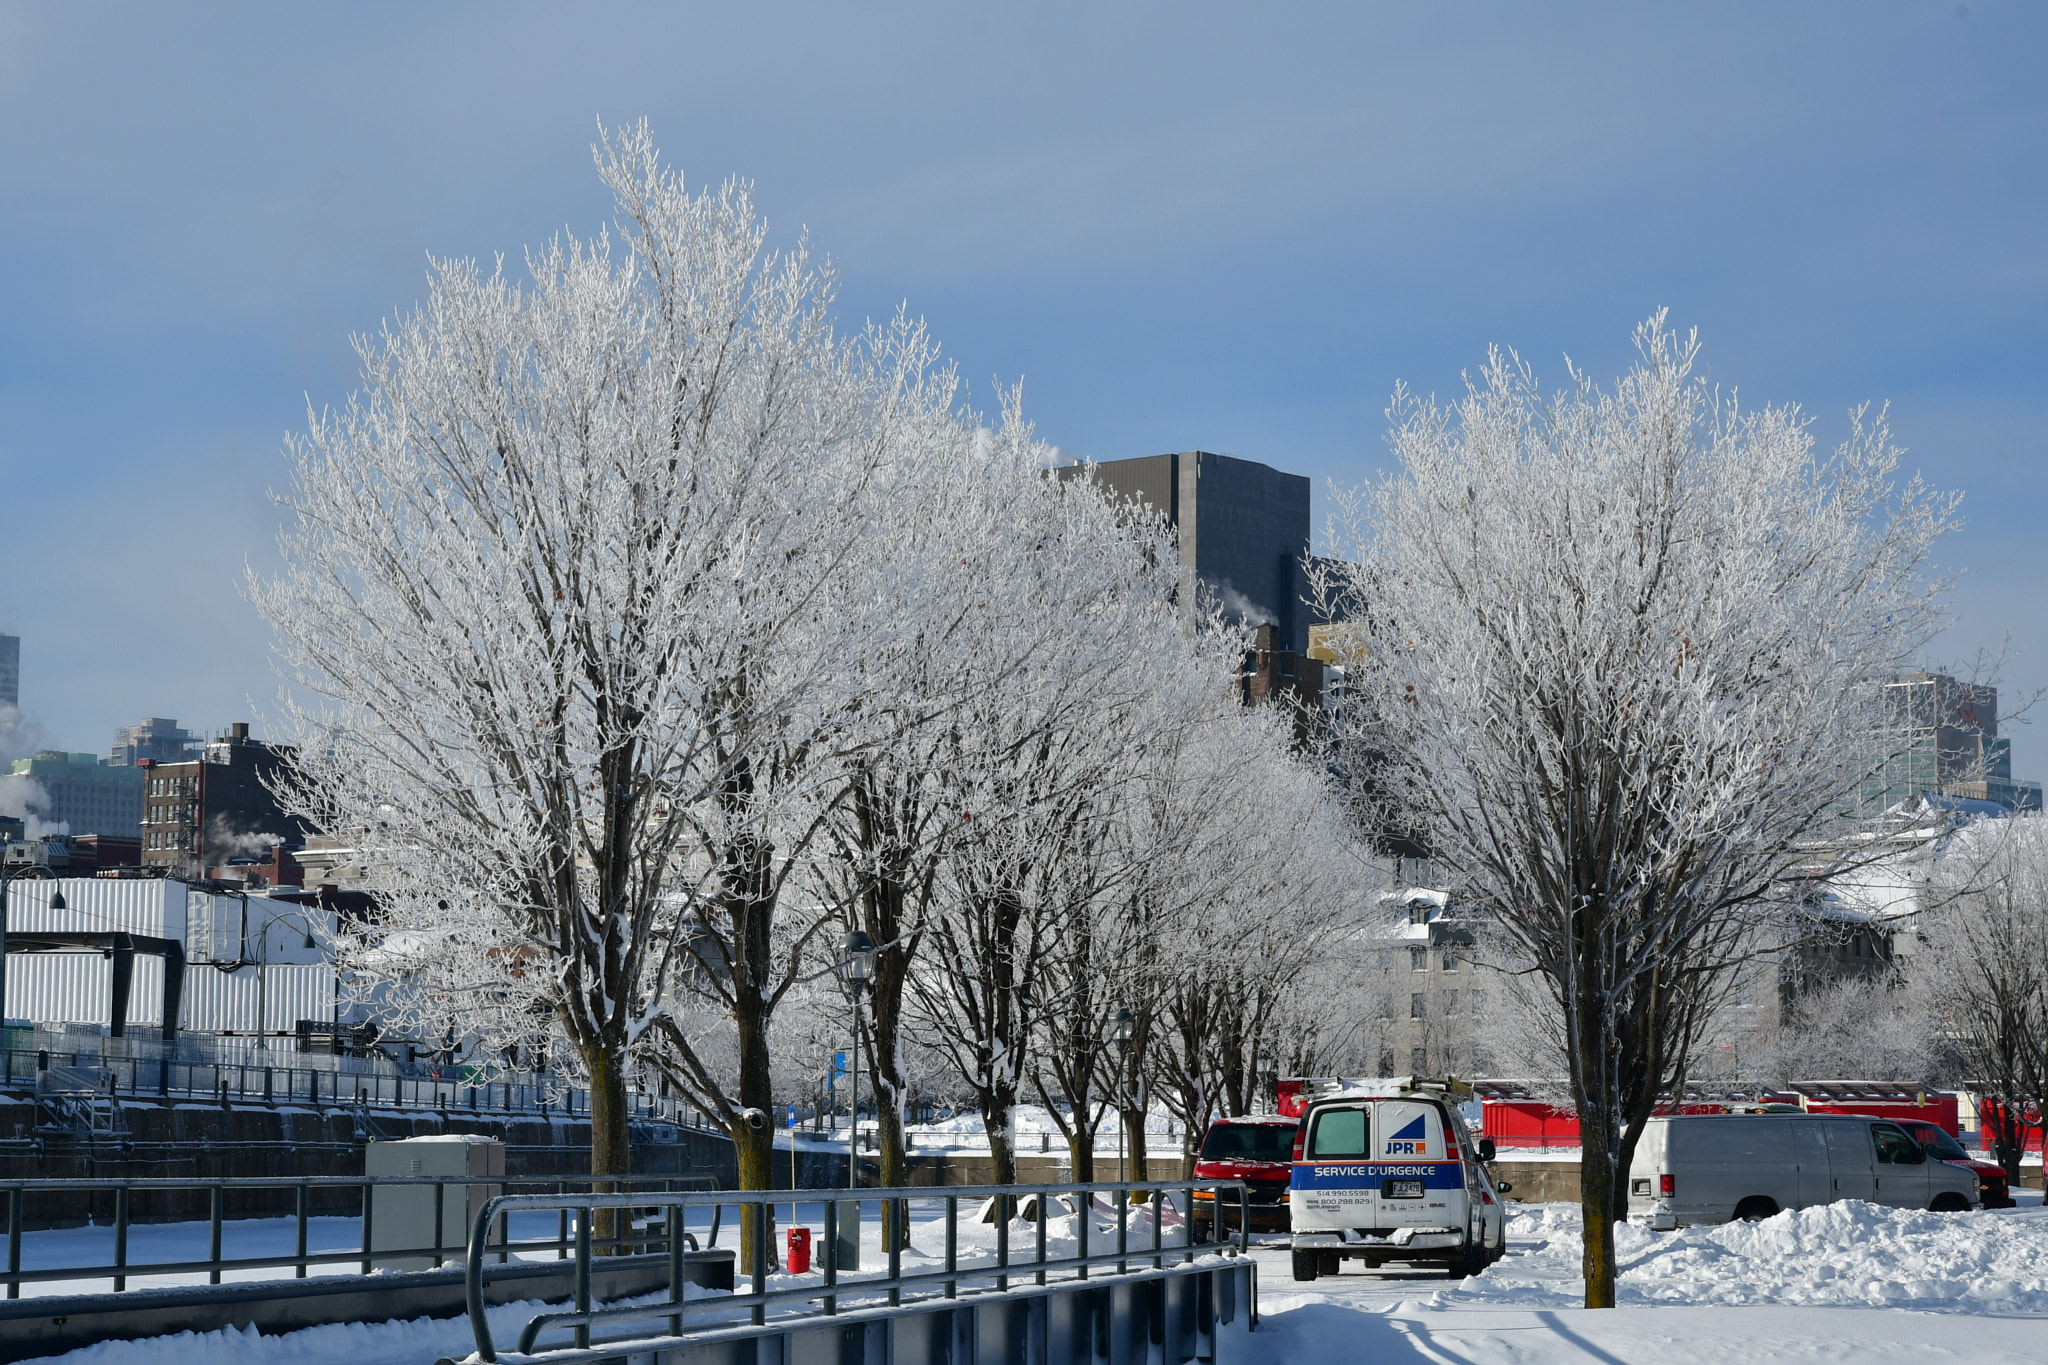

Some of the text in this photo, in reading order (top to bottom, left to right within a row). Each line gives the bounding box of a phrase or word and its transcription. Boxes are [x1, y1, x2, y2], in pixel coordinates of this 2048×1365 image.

[1385, 1142, 1414, 1155] JPR
[1314, 1166, 1436, 1177] SERVICE D'URGENCE
